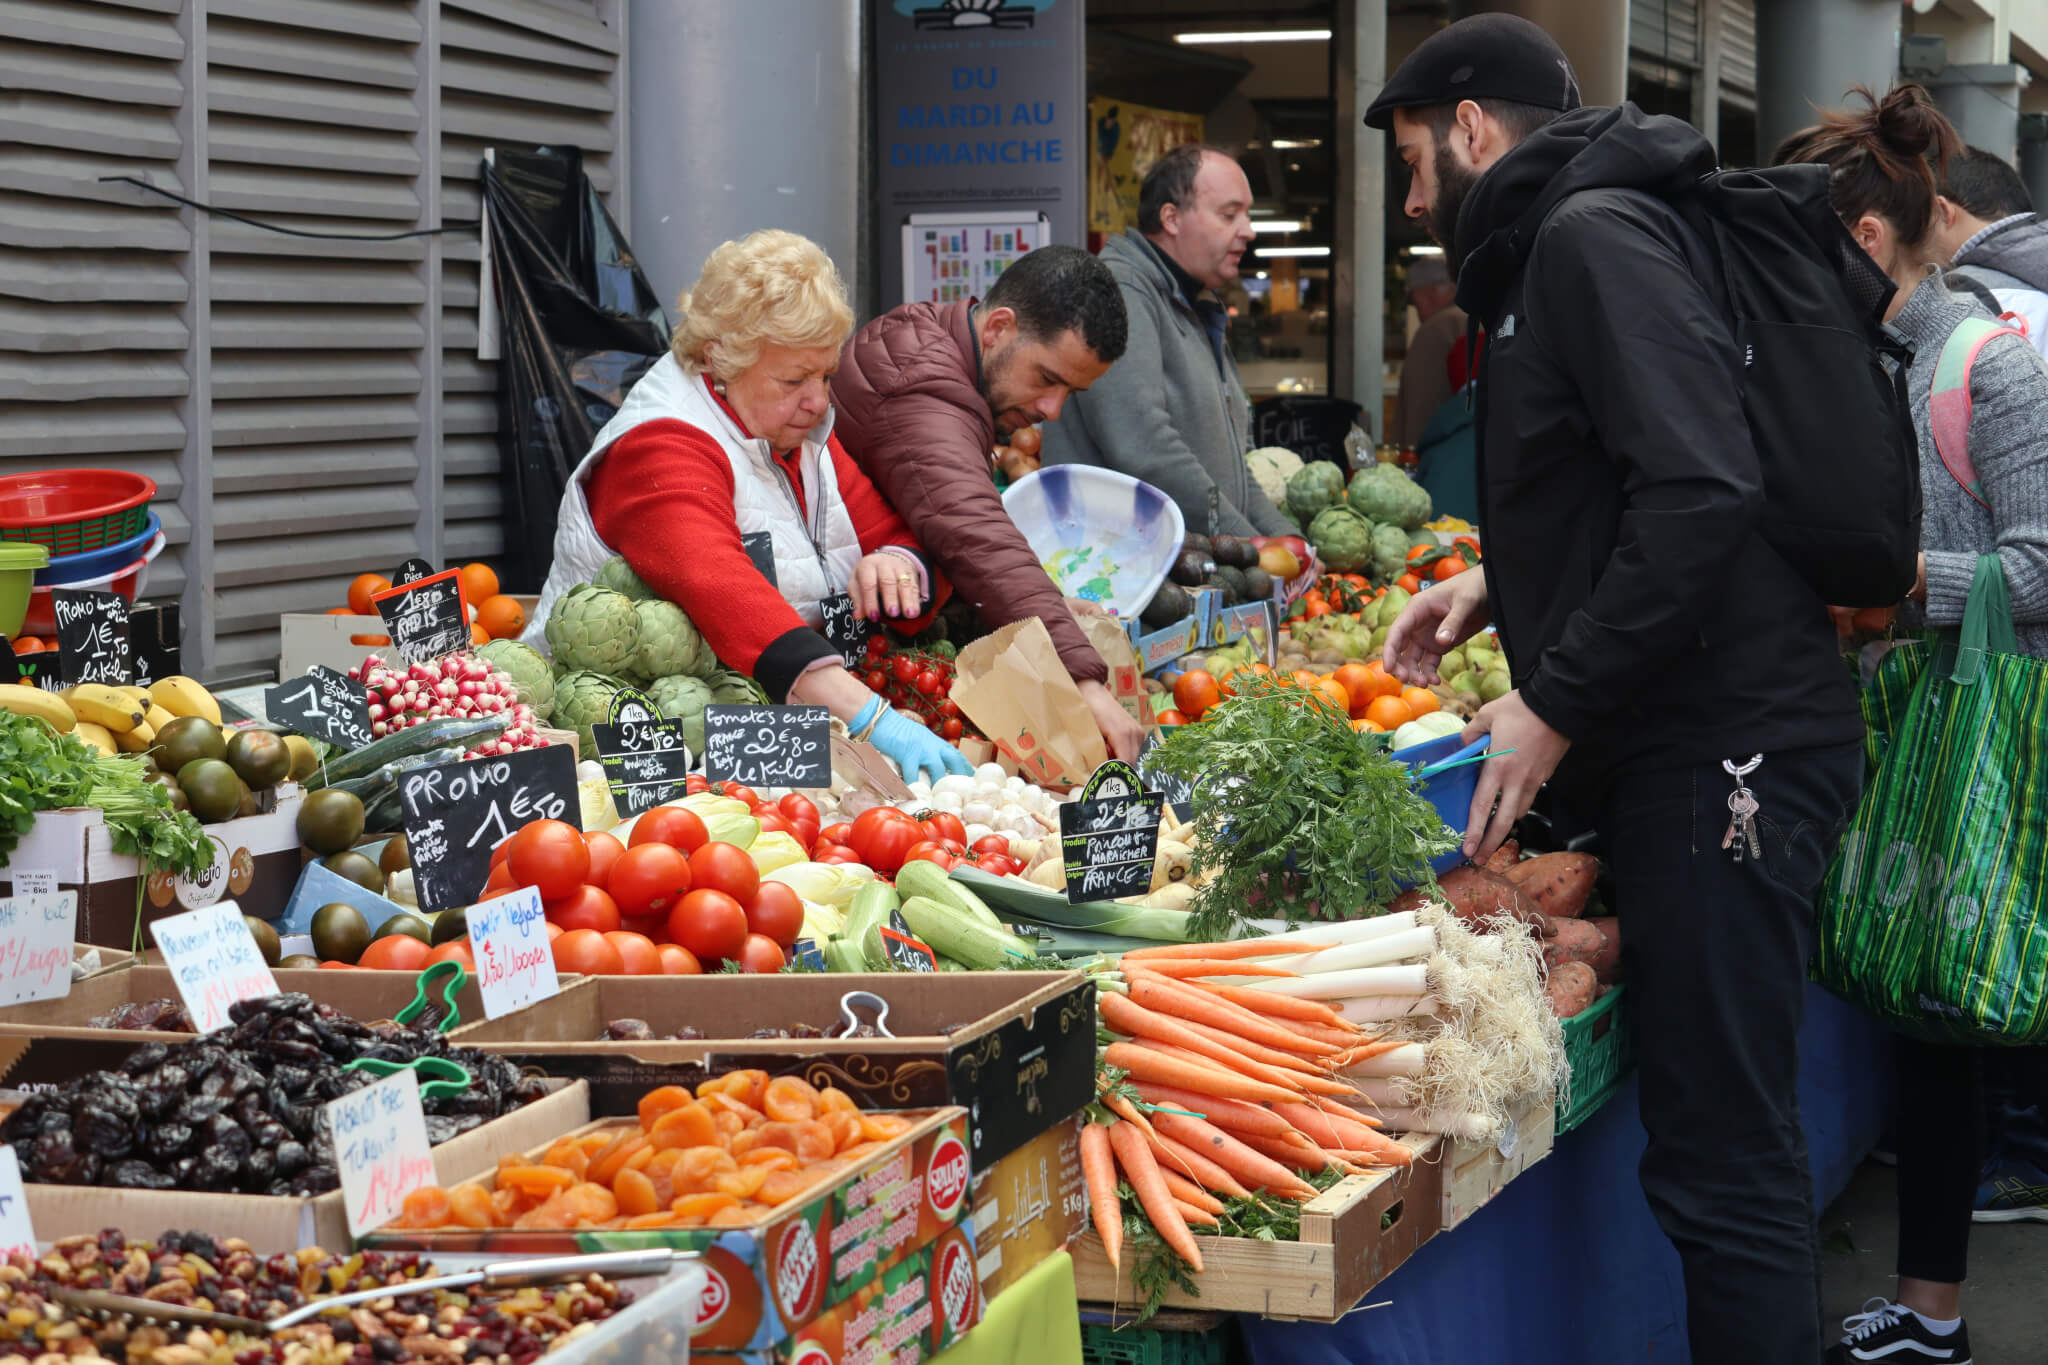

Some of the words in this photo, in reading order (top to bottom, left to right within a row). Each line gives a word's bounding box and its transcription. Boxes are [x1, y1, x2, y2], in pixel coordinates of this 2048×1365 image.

[953, 66, 997, 90] DU
[898, 103, 1003, 129] MARDI
[1012, 101, 1055, 125] AU
[890, 138, 1063, 168] DIMANCHE
[56, 600, 94, 630] PROMO
[707, 707, 776, 726] tomates
[405, 761, 511, 817] PROMO
[1104, 779, 1121, 794] 1kg
[1063, 837, 1087, 847] Produit
[1082, 864, 1140, 893] FRANCE
[1070, 1193, 1082, 1213] Kg
